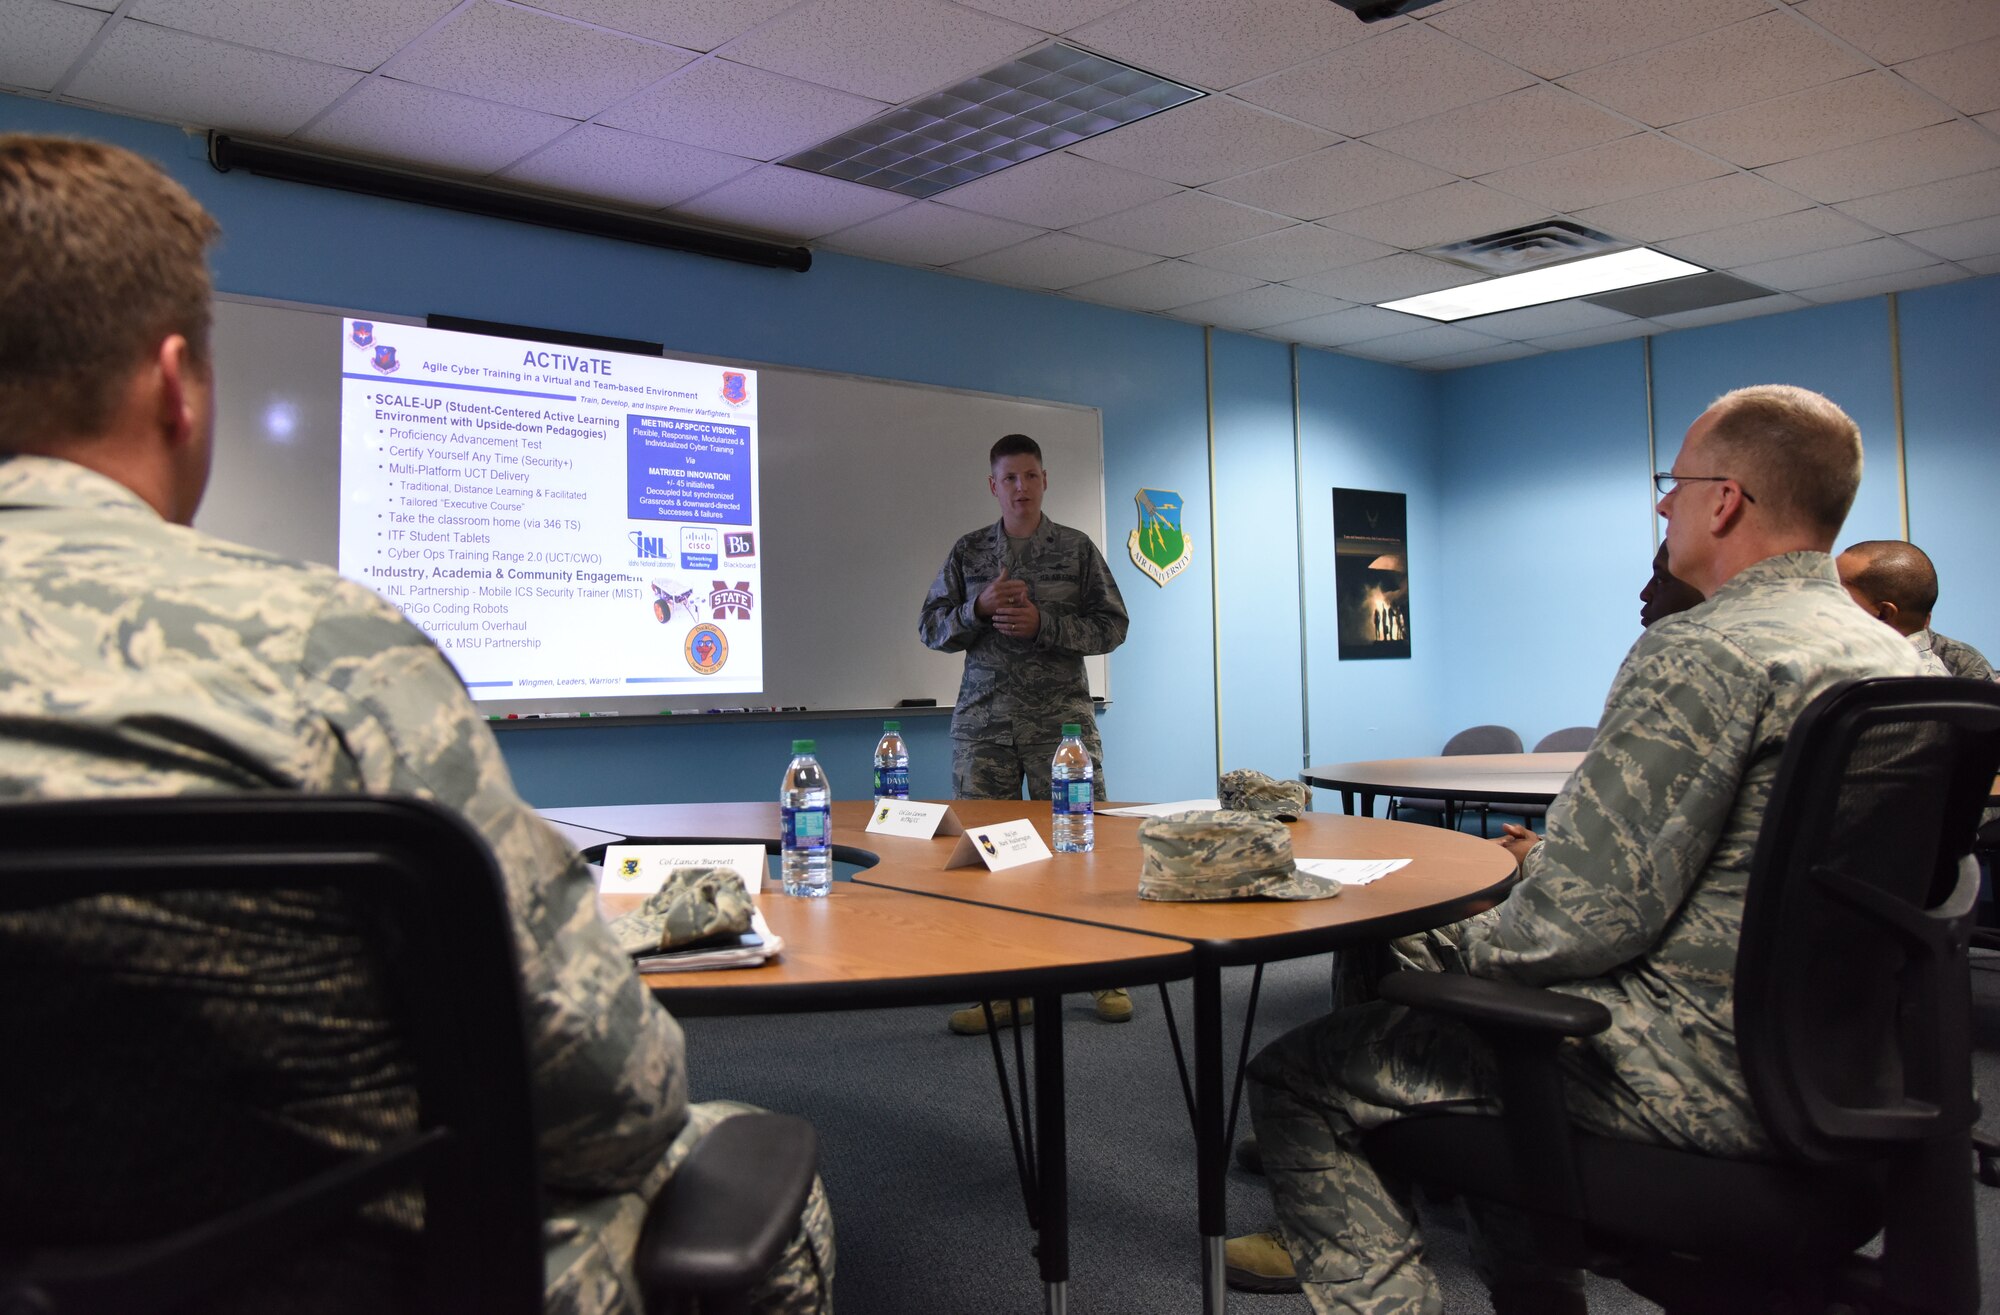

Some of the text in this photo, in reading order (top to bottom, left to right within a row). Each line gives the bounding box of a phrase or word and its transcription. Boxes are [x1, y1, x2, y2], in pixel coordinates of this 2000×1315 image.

[523, 351, 612, 376] ACTiVaTE
[422, 361, 448, 373] Agile
[451, 364, 480, 376] Cyber
[483, 368, 521, 382] Training
[523, 372, 532, 382] in
[542, 375, 572, 386] Virtual
[574, 378, 590, 388] and
[594, 380, 644, 394] Team-based
[646, 386, 699, 400] Environment
[375, 393, 620, 429] SCALE-UP (Student-Centered Active Learning
[580, 395, 730, 419] Train, Develop, and Inspire Premier Warfighters
[375, 410, 607, 440] Environment with Upside-down Pedagogies)
[641, 418, 737, 436] MEETING AFSPC/CC VISION:
[389, 427, 542, 450] Proficiency Advancement Test
[633, 427, 745, 446] Flexible, Responsive, Modularized &
[645, 438, 734, 456] Individualized Cyber Training
[389, 445, 573, 471] Certify Yourself Any Time (Security+)
[685, 457, 696, 465] Via
[389, 462, 530, 484] Multi-Platform UCT Delivery
[648, 467, 731, 481] MATRIXED INNOVATION!
[400, 480, 587, 500] Traditional, Distance Learning & Facilitated
[646, 487, 734, 501] Decoupled but synchronized
[676, 480, 685, 488] 45
[686, 481, 715, 490] initiatives
[400, 496, 438, 508] Tailored
[639, 496, 741, 511] Grassroots & downward-directed
[388, 511, 581, 532] Take the classroom home (via 346 TS)
[658, 507, 724, 519] Successes & failures
[388, 529, 490, 544] ITF Student Tablets
[728, 536, 750, 554] Bb
[388, 547, 602, 565] Cyber Ops Training Range 2.0 (UCT/CWO)
[723, 561, 756, 569] Blackboard
[371, 565, 428, 581] Industry,
[432, 566, 492, 579] Academia
[495, 568, 504, 579] &
[507, 568, 573, 583] Community
[1134, 552, 1189, 581] AIR UNIVERSITY
[387, 585, 405, 596] INL
[409, 585, 470, 599] Partnership
[479, 586, 512, 597] Mobile
[515, 586, 533, 597] ICS
[535, 586, 574, 599] Security
[576, 587, 609, 598] Trainer
[611, 588, 643, 600] (MIST)
[714, 591, 748, 606] STATE
[433, 602, 470, 616] Coding
[473, 603, 509, 614] Robots
[422, 620, 479, 631] Curriculum
[481, 620, 527, 631] Overhaul
[445, 638, 453, 649] &
[456, 637, 482, 649] MSU
[484, 637, 542, 650] Partnership
[518, 677, 621, 688] Wingmen, Leaders, Warriors!
[659, 858, 734, 866] Col Lance Burnett
